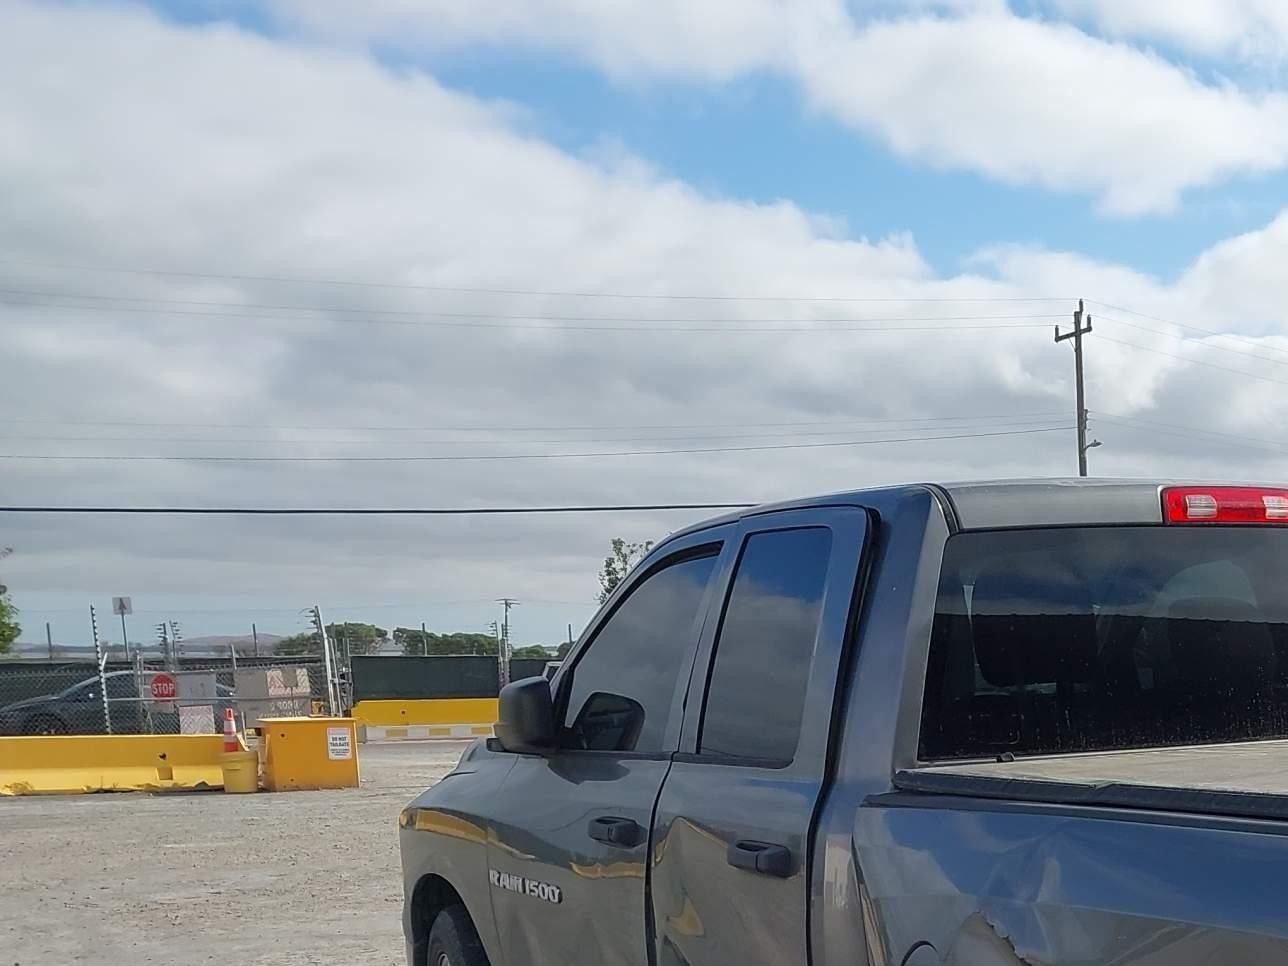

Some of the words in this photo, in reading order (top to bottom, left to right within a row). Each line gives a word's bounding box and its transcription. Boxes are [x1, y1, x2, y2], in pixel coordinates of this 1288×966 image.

[152, 683, 175, 696] STOP
[489, 869, 523, 893] RAM
[524, 879, 561, 903] 1500
